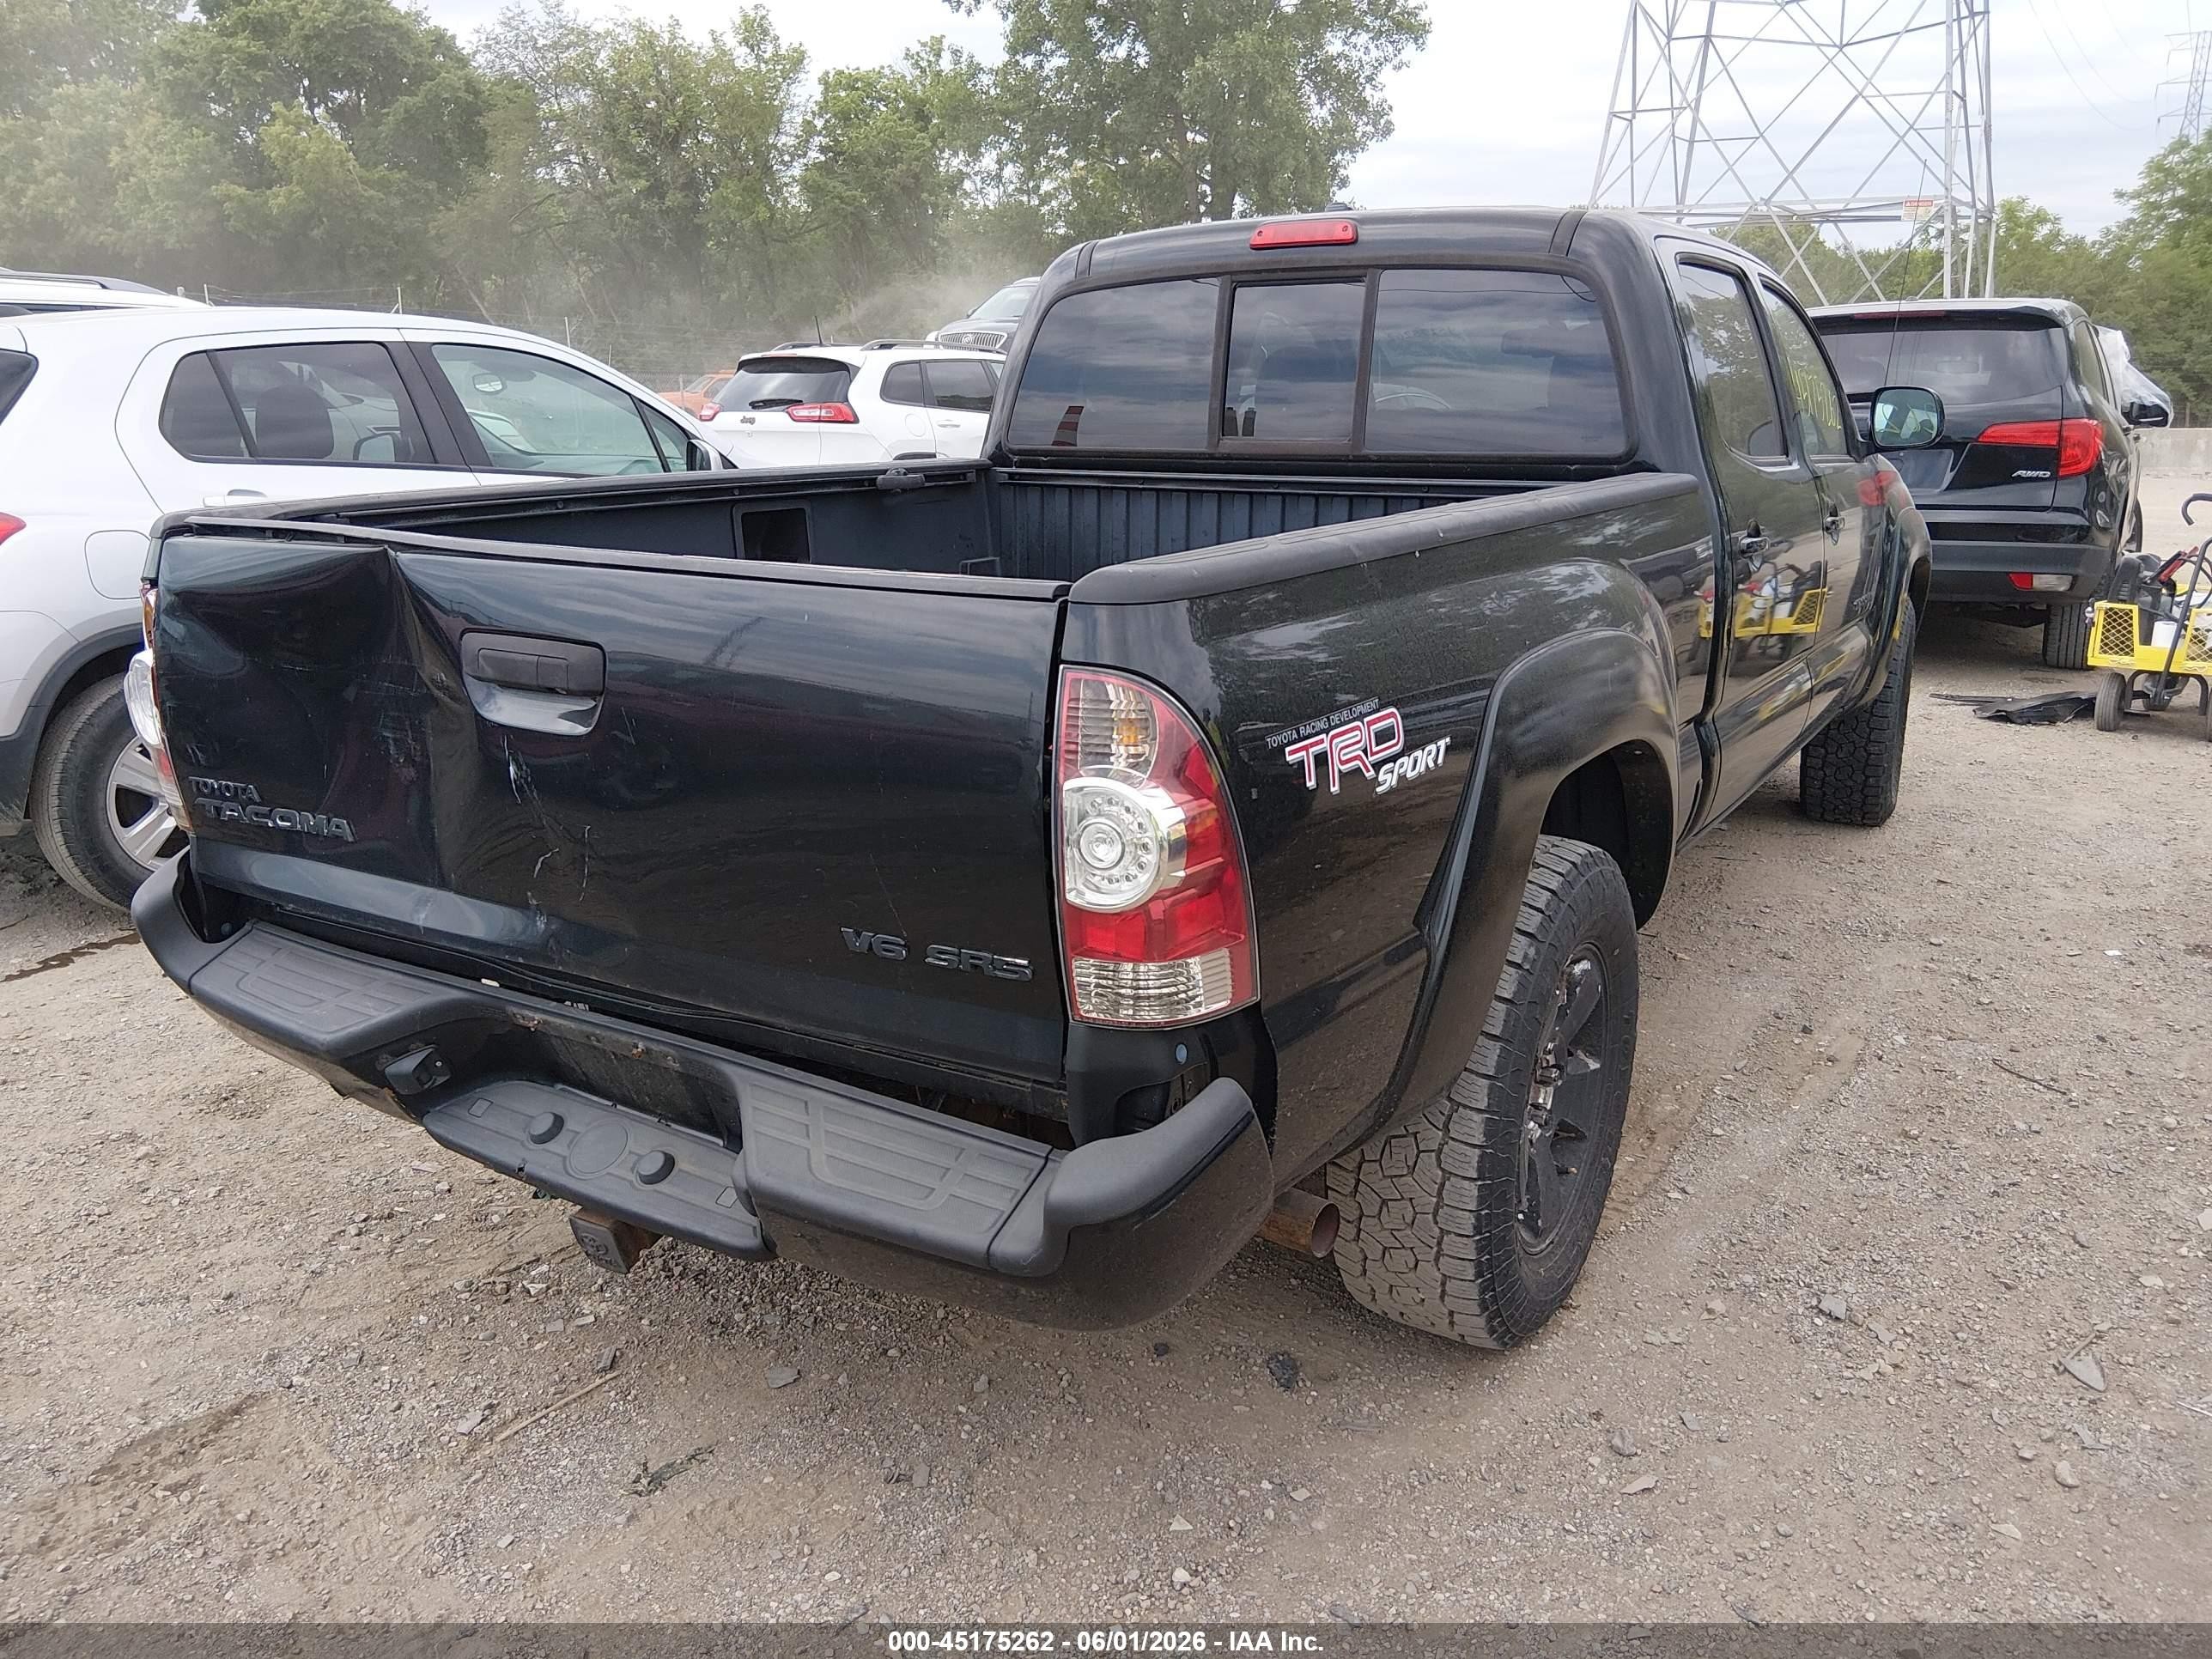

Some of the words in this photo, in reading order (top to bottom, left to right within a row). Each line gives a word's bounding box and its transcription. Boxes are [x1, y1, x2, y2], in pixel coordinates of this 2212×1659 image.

[2011, 470, 2051, 478] AWD
[1266, 731, 1297, 750] TOYOTA
[1299, 719, 1329, 738] RACING
[1330, 698, 1380, 727] DEVELOPMENT
[1285, 706, 1404, 795] TRD
[1375, 735, 1451, 795] SPORT
[187, 775, 262, 803] TOYOTA
[194, 797, 357, 843] TACOMA
[840, 927, 908, 961] V6
[924, 944, 1033, 982] SR5
